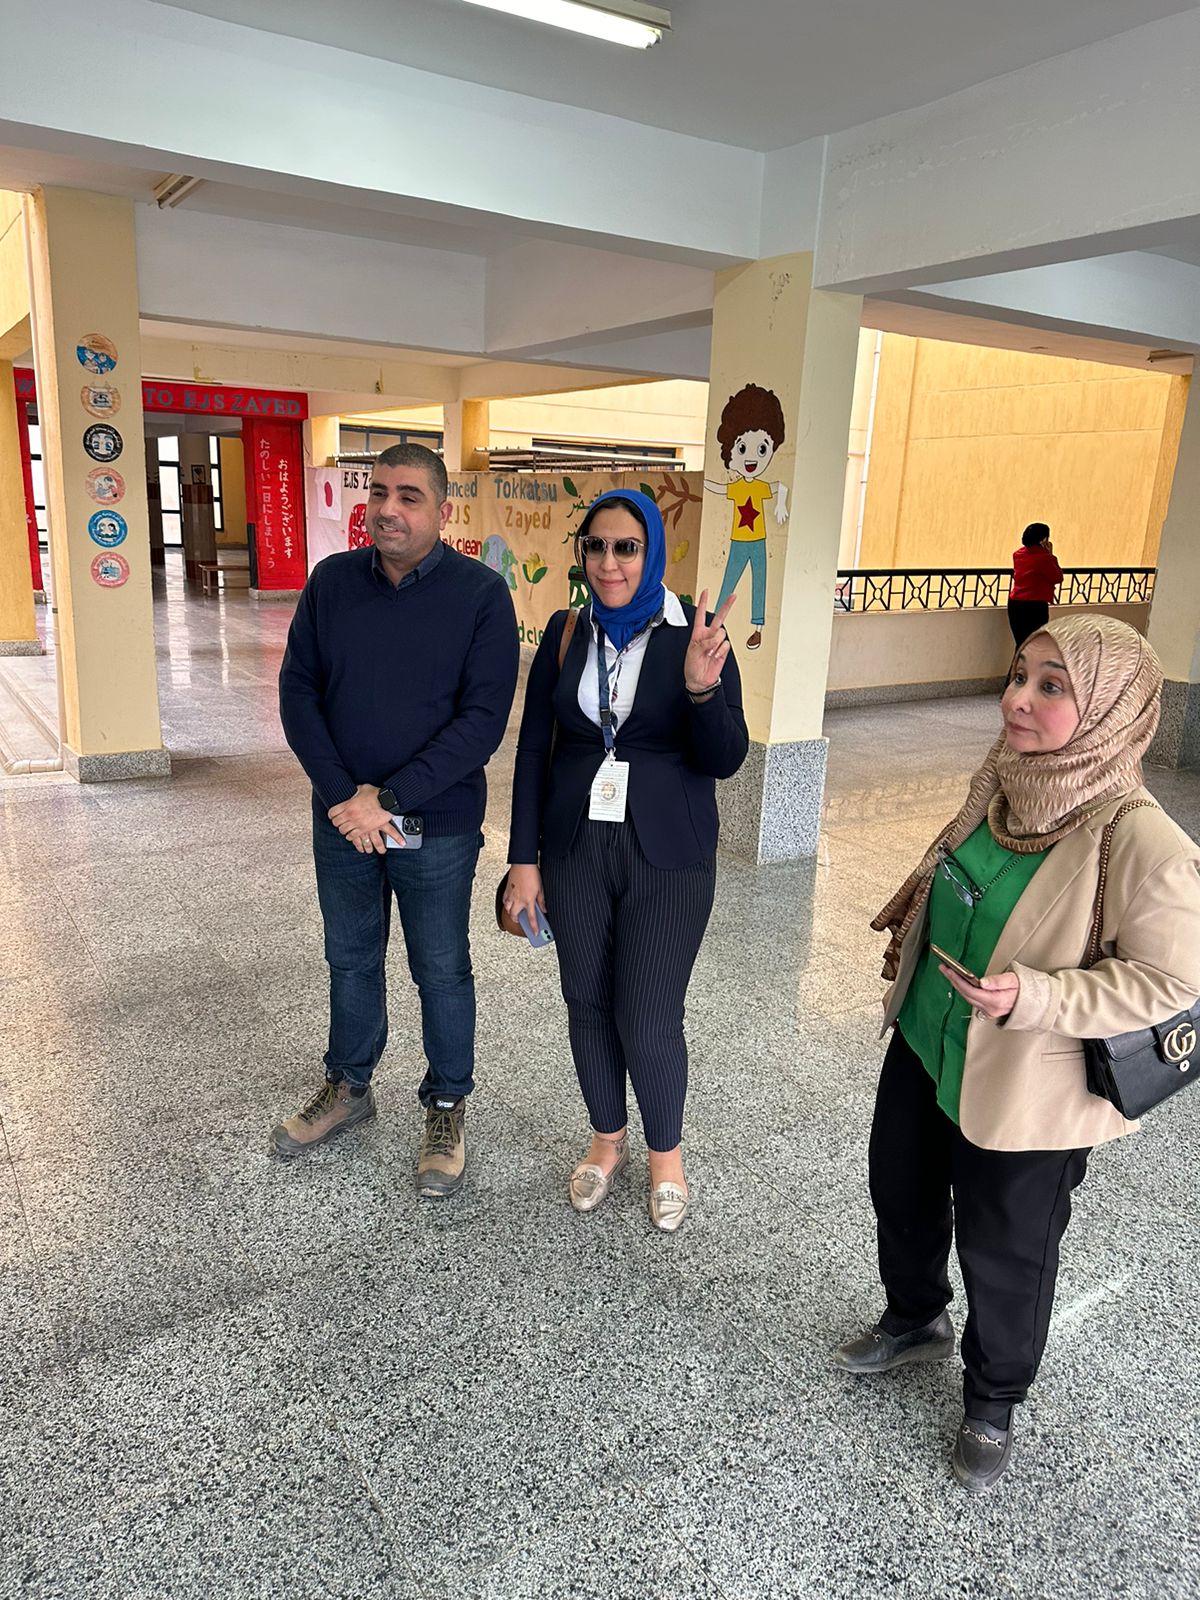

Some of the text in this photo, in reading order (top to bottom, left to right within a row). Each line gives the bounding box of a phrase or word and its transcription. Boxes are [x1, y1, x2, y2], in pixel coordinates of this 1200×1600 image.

[144, 387, 174, 406] TO
[184, 390, 225, 410] EJS
[230, 393, 301, 416] ZAYED
[343, 471, 360, 490] EJS
[446, 475, 558, 502] anced Tokkatsu
[278, 459, 294, 559] おはようございます
[448, 503, 471, 525] JS
[504, 504, 551, 536] Zayed
[456, 537, 483, 557] clean
